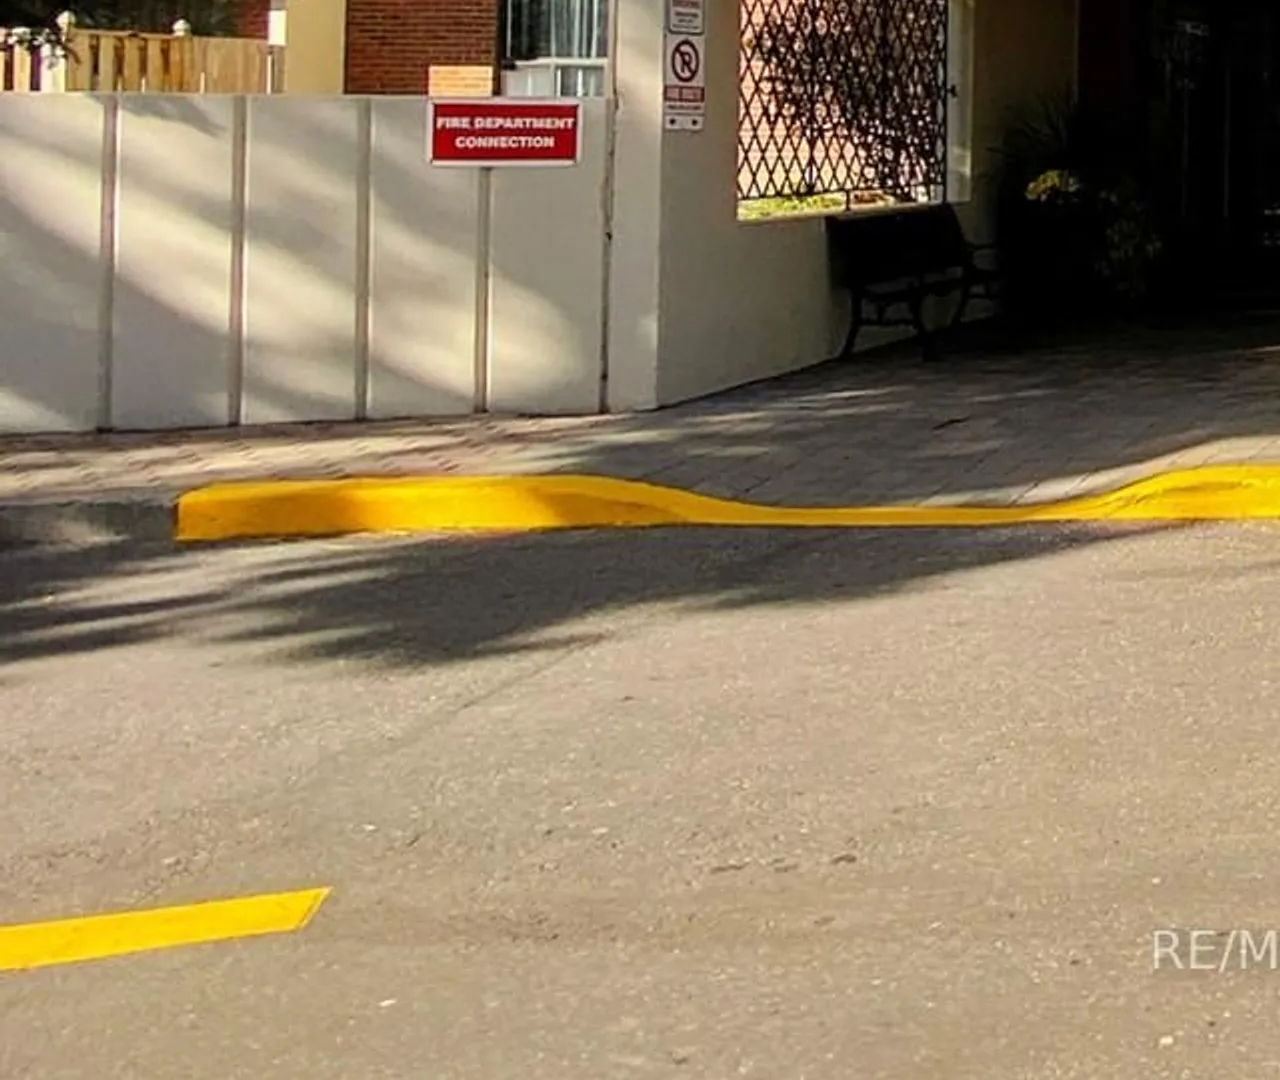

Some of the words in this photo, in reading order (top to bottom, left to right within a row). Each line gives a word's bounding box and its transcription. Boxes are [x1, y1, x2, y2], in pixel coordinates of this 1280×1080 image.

[436, 116, 471, 129] FIRE
[474, 117, 575, 130] DEPARTMENT
[455, 135, 555, 149] CONNECTION
